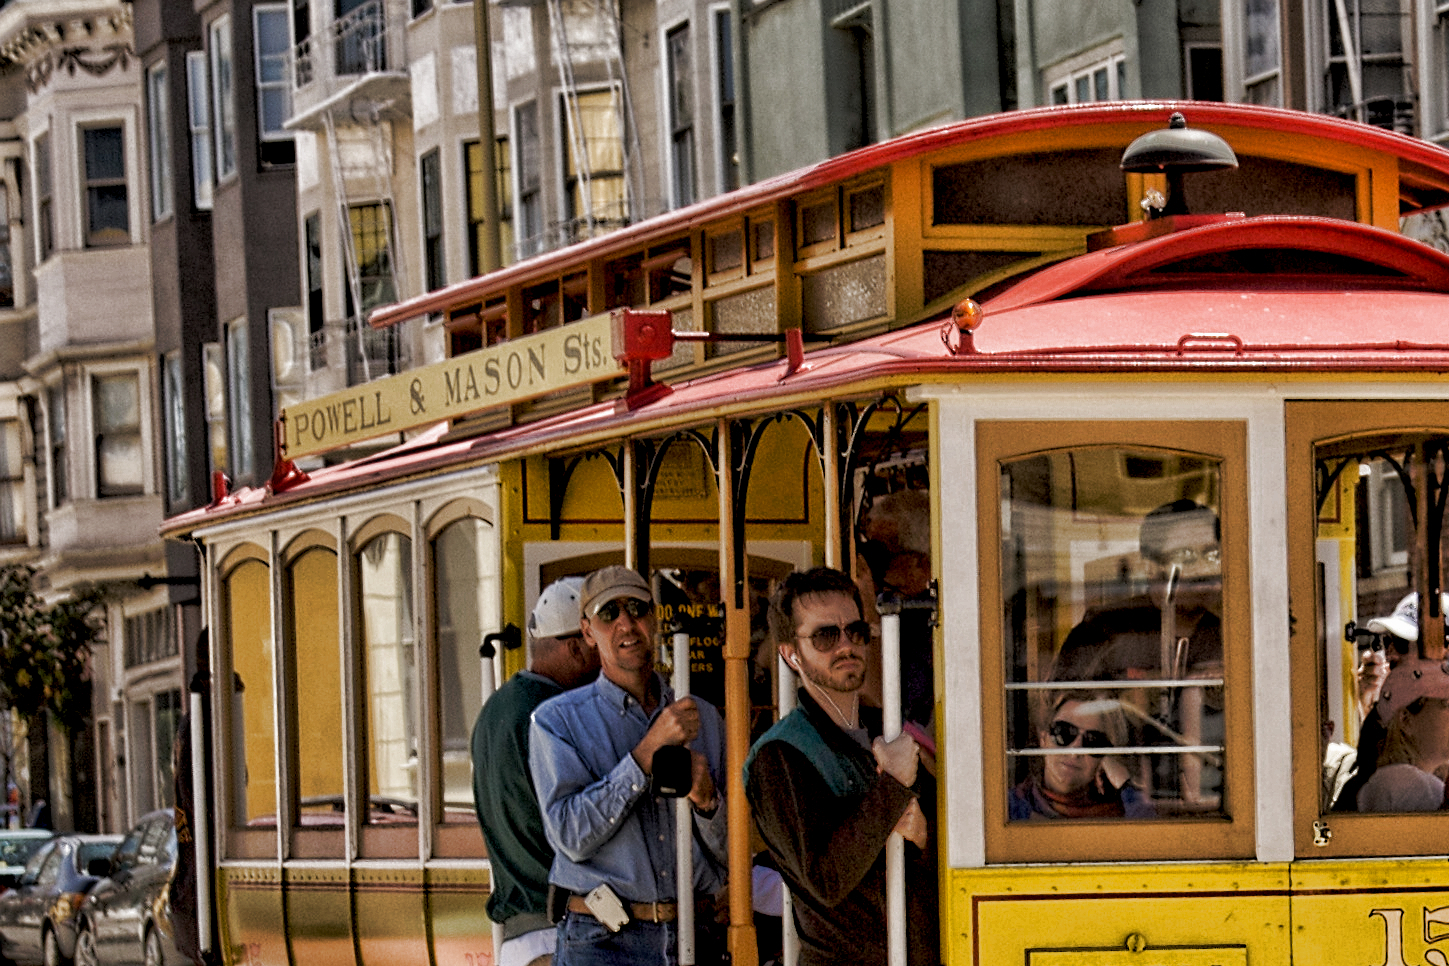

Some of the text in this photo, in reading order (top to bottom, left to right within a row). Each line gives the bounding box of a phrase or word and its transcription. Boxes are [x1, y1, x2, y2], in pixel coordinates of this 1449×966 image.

[294, 333, 608, 446] POWELL & MASON Sts.
